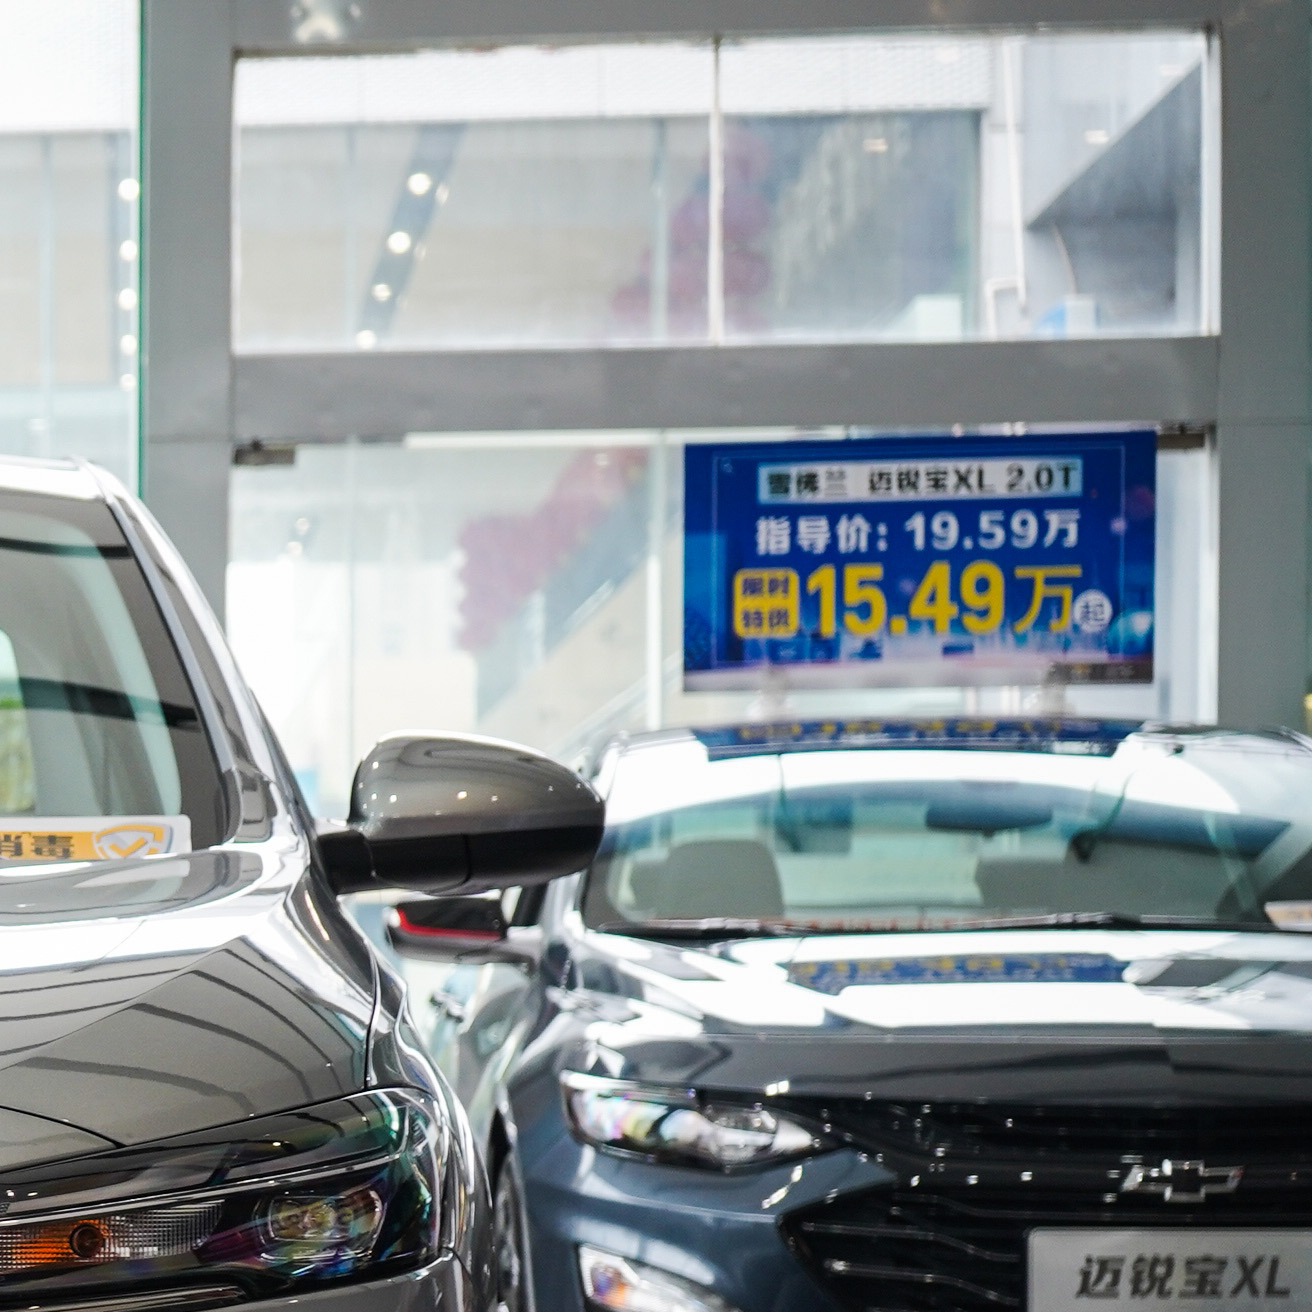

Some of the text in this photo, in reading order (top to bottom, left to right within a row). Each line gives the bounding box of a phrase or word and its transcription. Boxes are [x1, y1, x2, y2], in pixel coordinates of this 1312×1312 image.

[868, 463, 997, 495] 迈锐宝XL
[1005, 460, 1078, 492] 2.0T
[805, 558, 1083, 639] 15.49万
[1075, 1253, 1291, 1299] 迈锐宝XL
